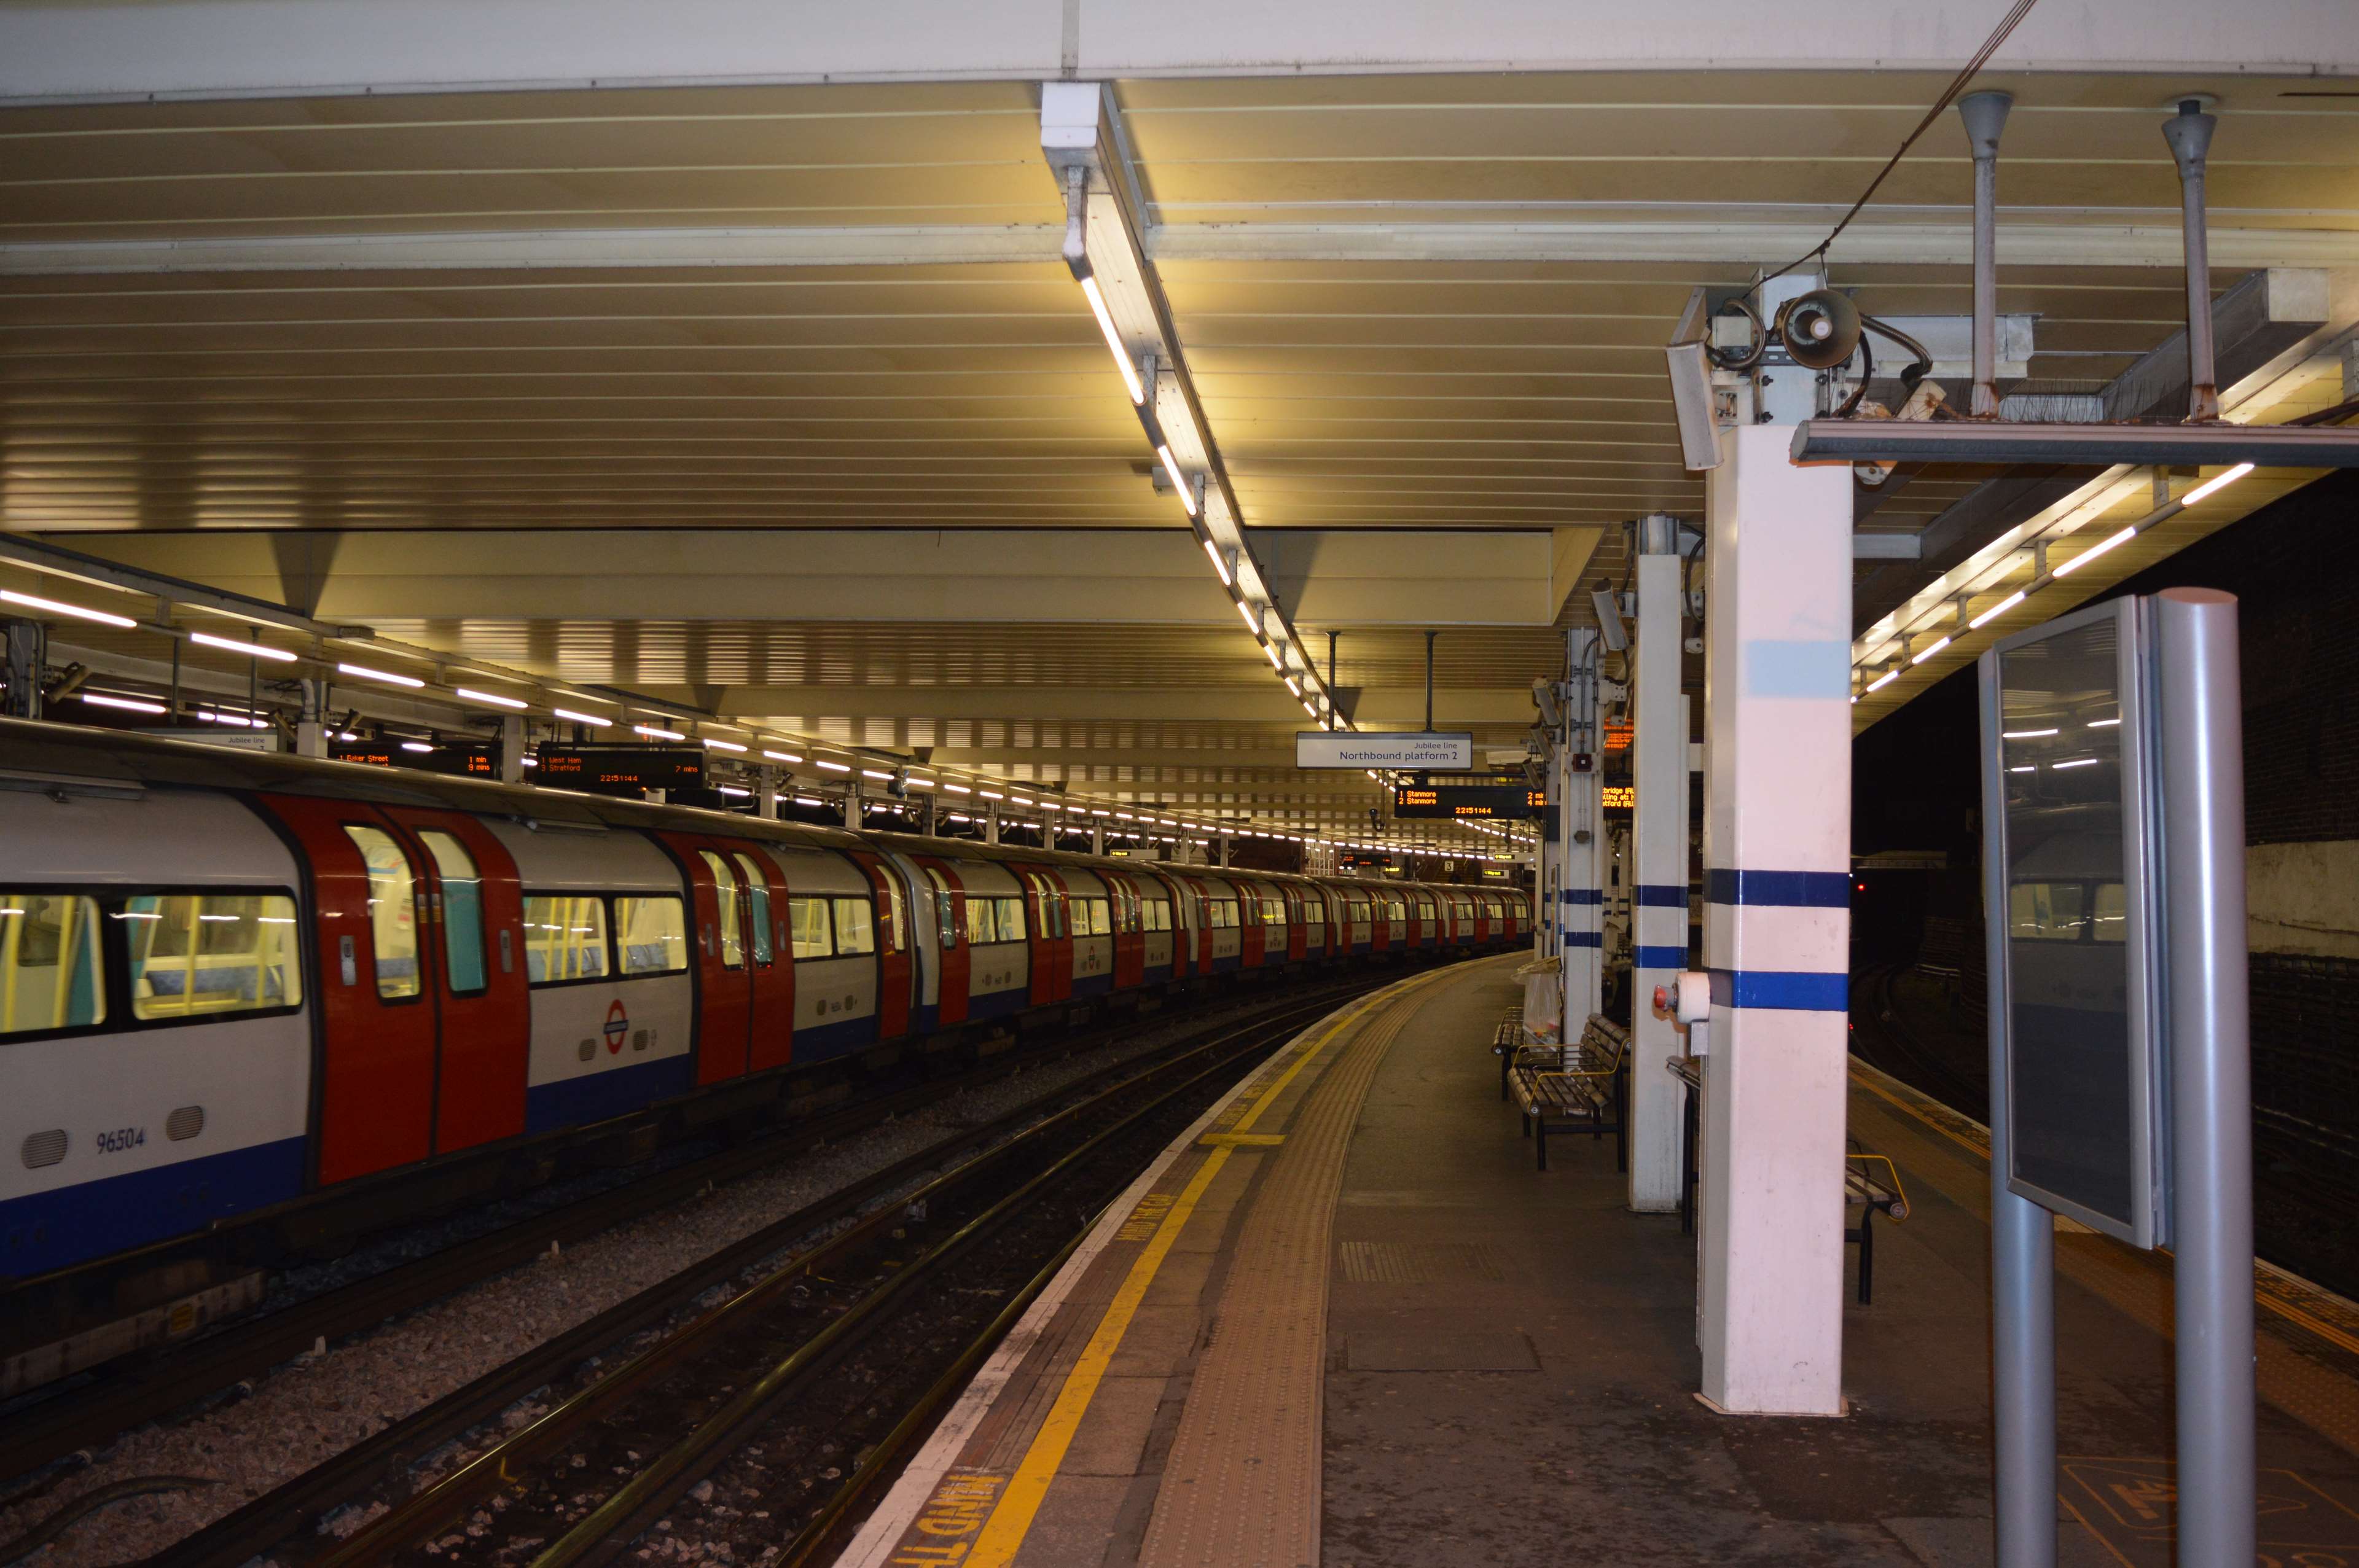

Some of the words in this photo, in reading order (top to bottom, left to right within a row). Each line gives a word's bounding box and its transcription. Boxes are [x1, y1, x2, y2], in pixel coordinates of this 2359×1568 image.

[1340, 751, 1401, 760] Northbound
[1405, 751, 1449, 761] platform
[1452, 751, 1458, 760] 2
[96, 1127, 144, 1154] 96504
[917, 1475, 1004, 1535] MIND
